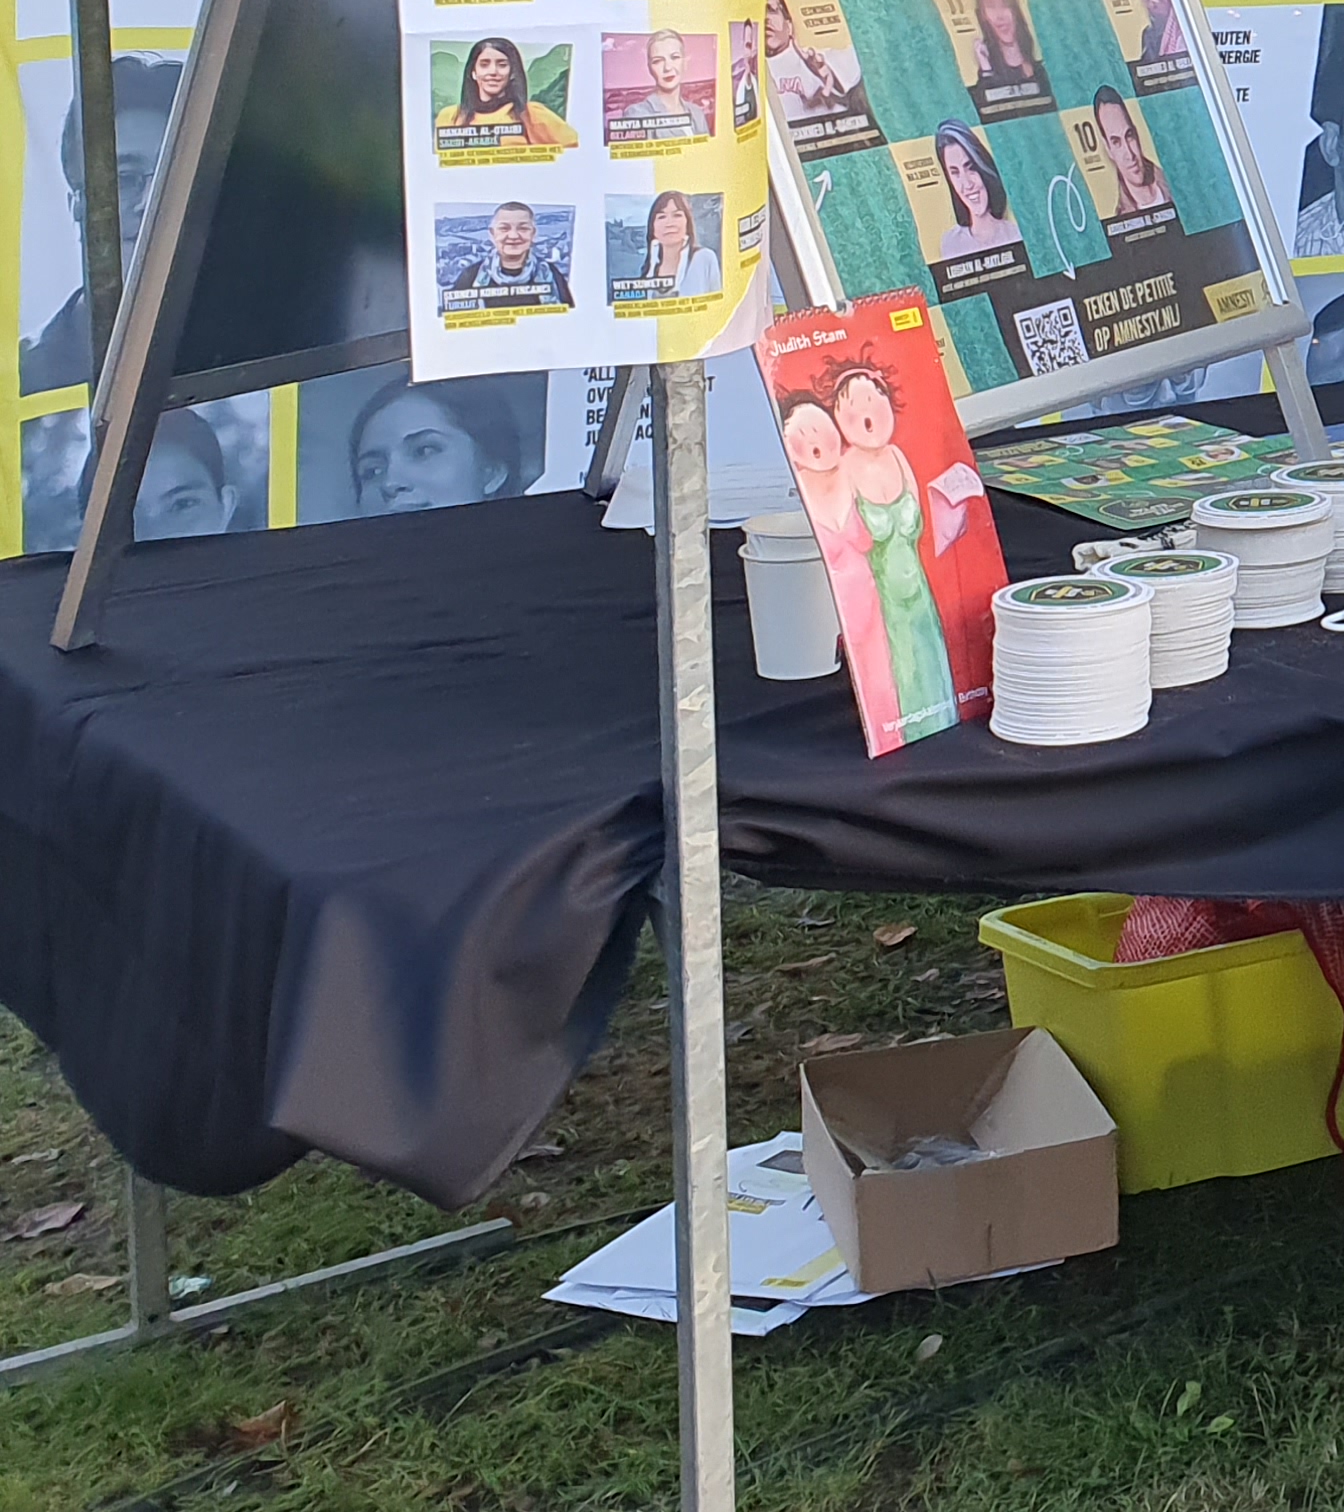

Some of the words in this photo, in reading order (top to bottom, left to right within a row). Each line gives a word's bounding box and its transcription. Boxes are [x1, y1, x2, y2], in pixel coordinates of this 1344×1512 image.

[1074, 120, 1098, 153] 10
[1083, 291, 1122, 322] TEKEN
[1119, 285, 1137, 311] DE
[1136, 272, 1177, 306] PETITIE
[1216, 289, 1256, 314] AMNESTY
[770, 337, 811, 356] Judith
[813, 328, 847, 346] Stam
[1094, 326, 1111, 352] OP
